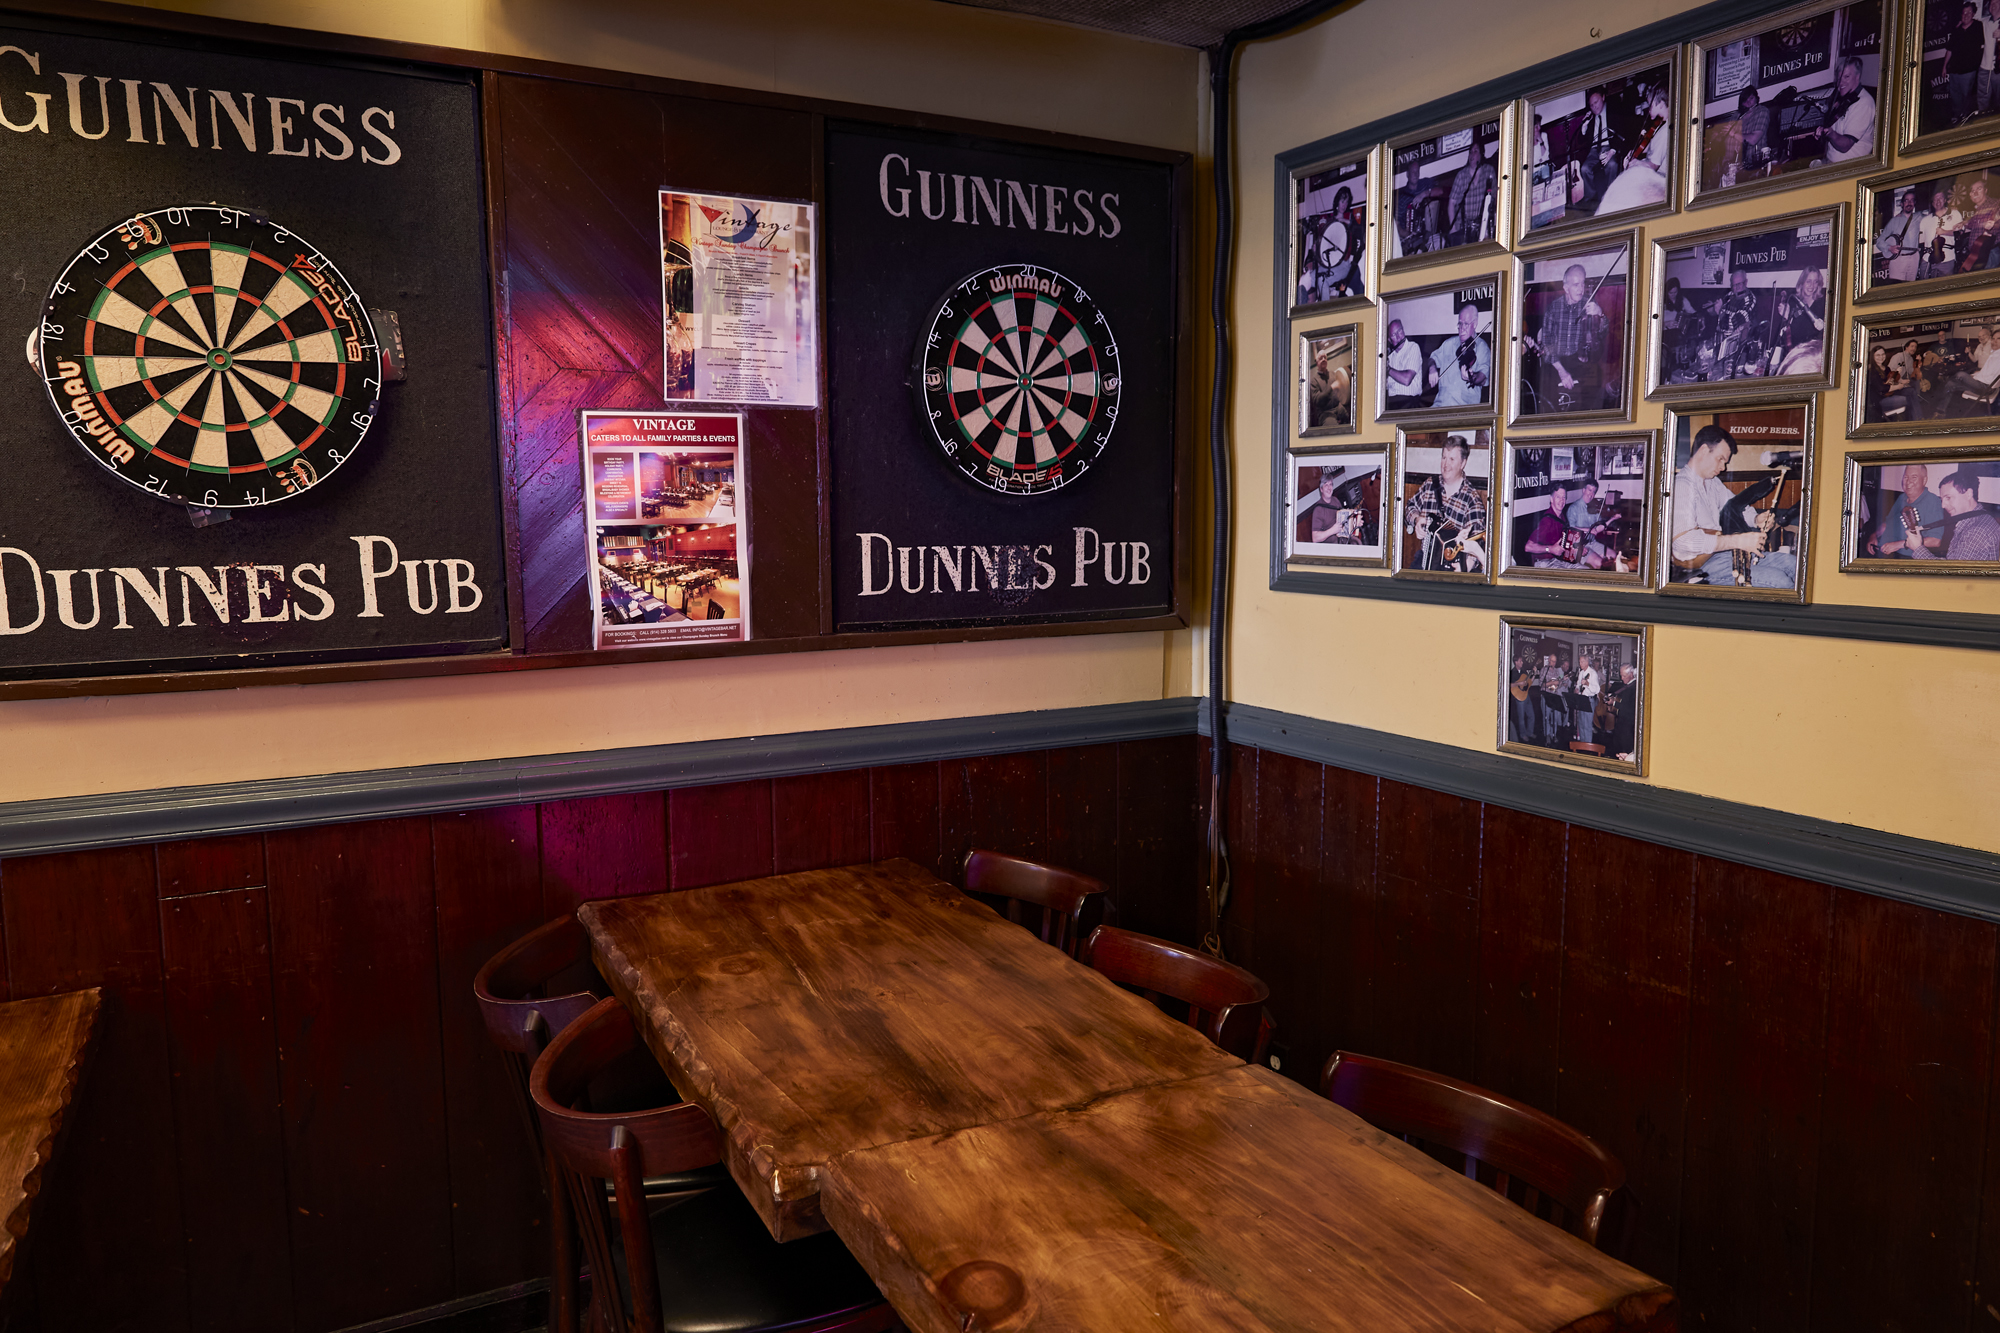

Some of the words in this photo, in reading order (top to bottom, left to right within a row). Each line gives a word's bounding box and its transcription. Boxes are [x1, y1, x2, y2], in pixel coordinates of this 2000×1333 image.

[1763, 58, 1802, 79] DUNNES
[1805, 52, 1823, 66] PUB
[0, 44, 402, 166] GUINNESS
[1420, 143, 1435, 158] PUB
[879, 153, 1122, 238] GUINNESS
[1800, 234, 1819, 242] ENJOY
[1736, 252, 1768, 265] DUNNES
[1770, 247, 1787, 262] PUB
[989, 274, 1062, 298] WINMAU
[1879, 329, 1890, 337] PUB
[633, 419, 696, 431] VINTAGE
[1729, 426, 1755, 434] KING
[1770, 427, 1800, 435] BEERS.
[591, 434, 620, 442] CATERS
[1539, 472, 1549, 486] PUB
[1070, 526, 1151, 588] PUB
[350, 535, 484, 619] PUB
